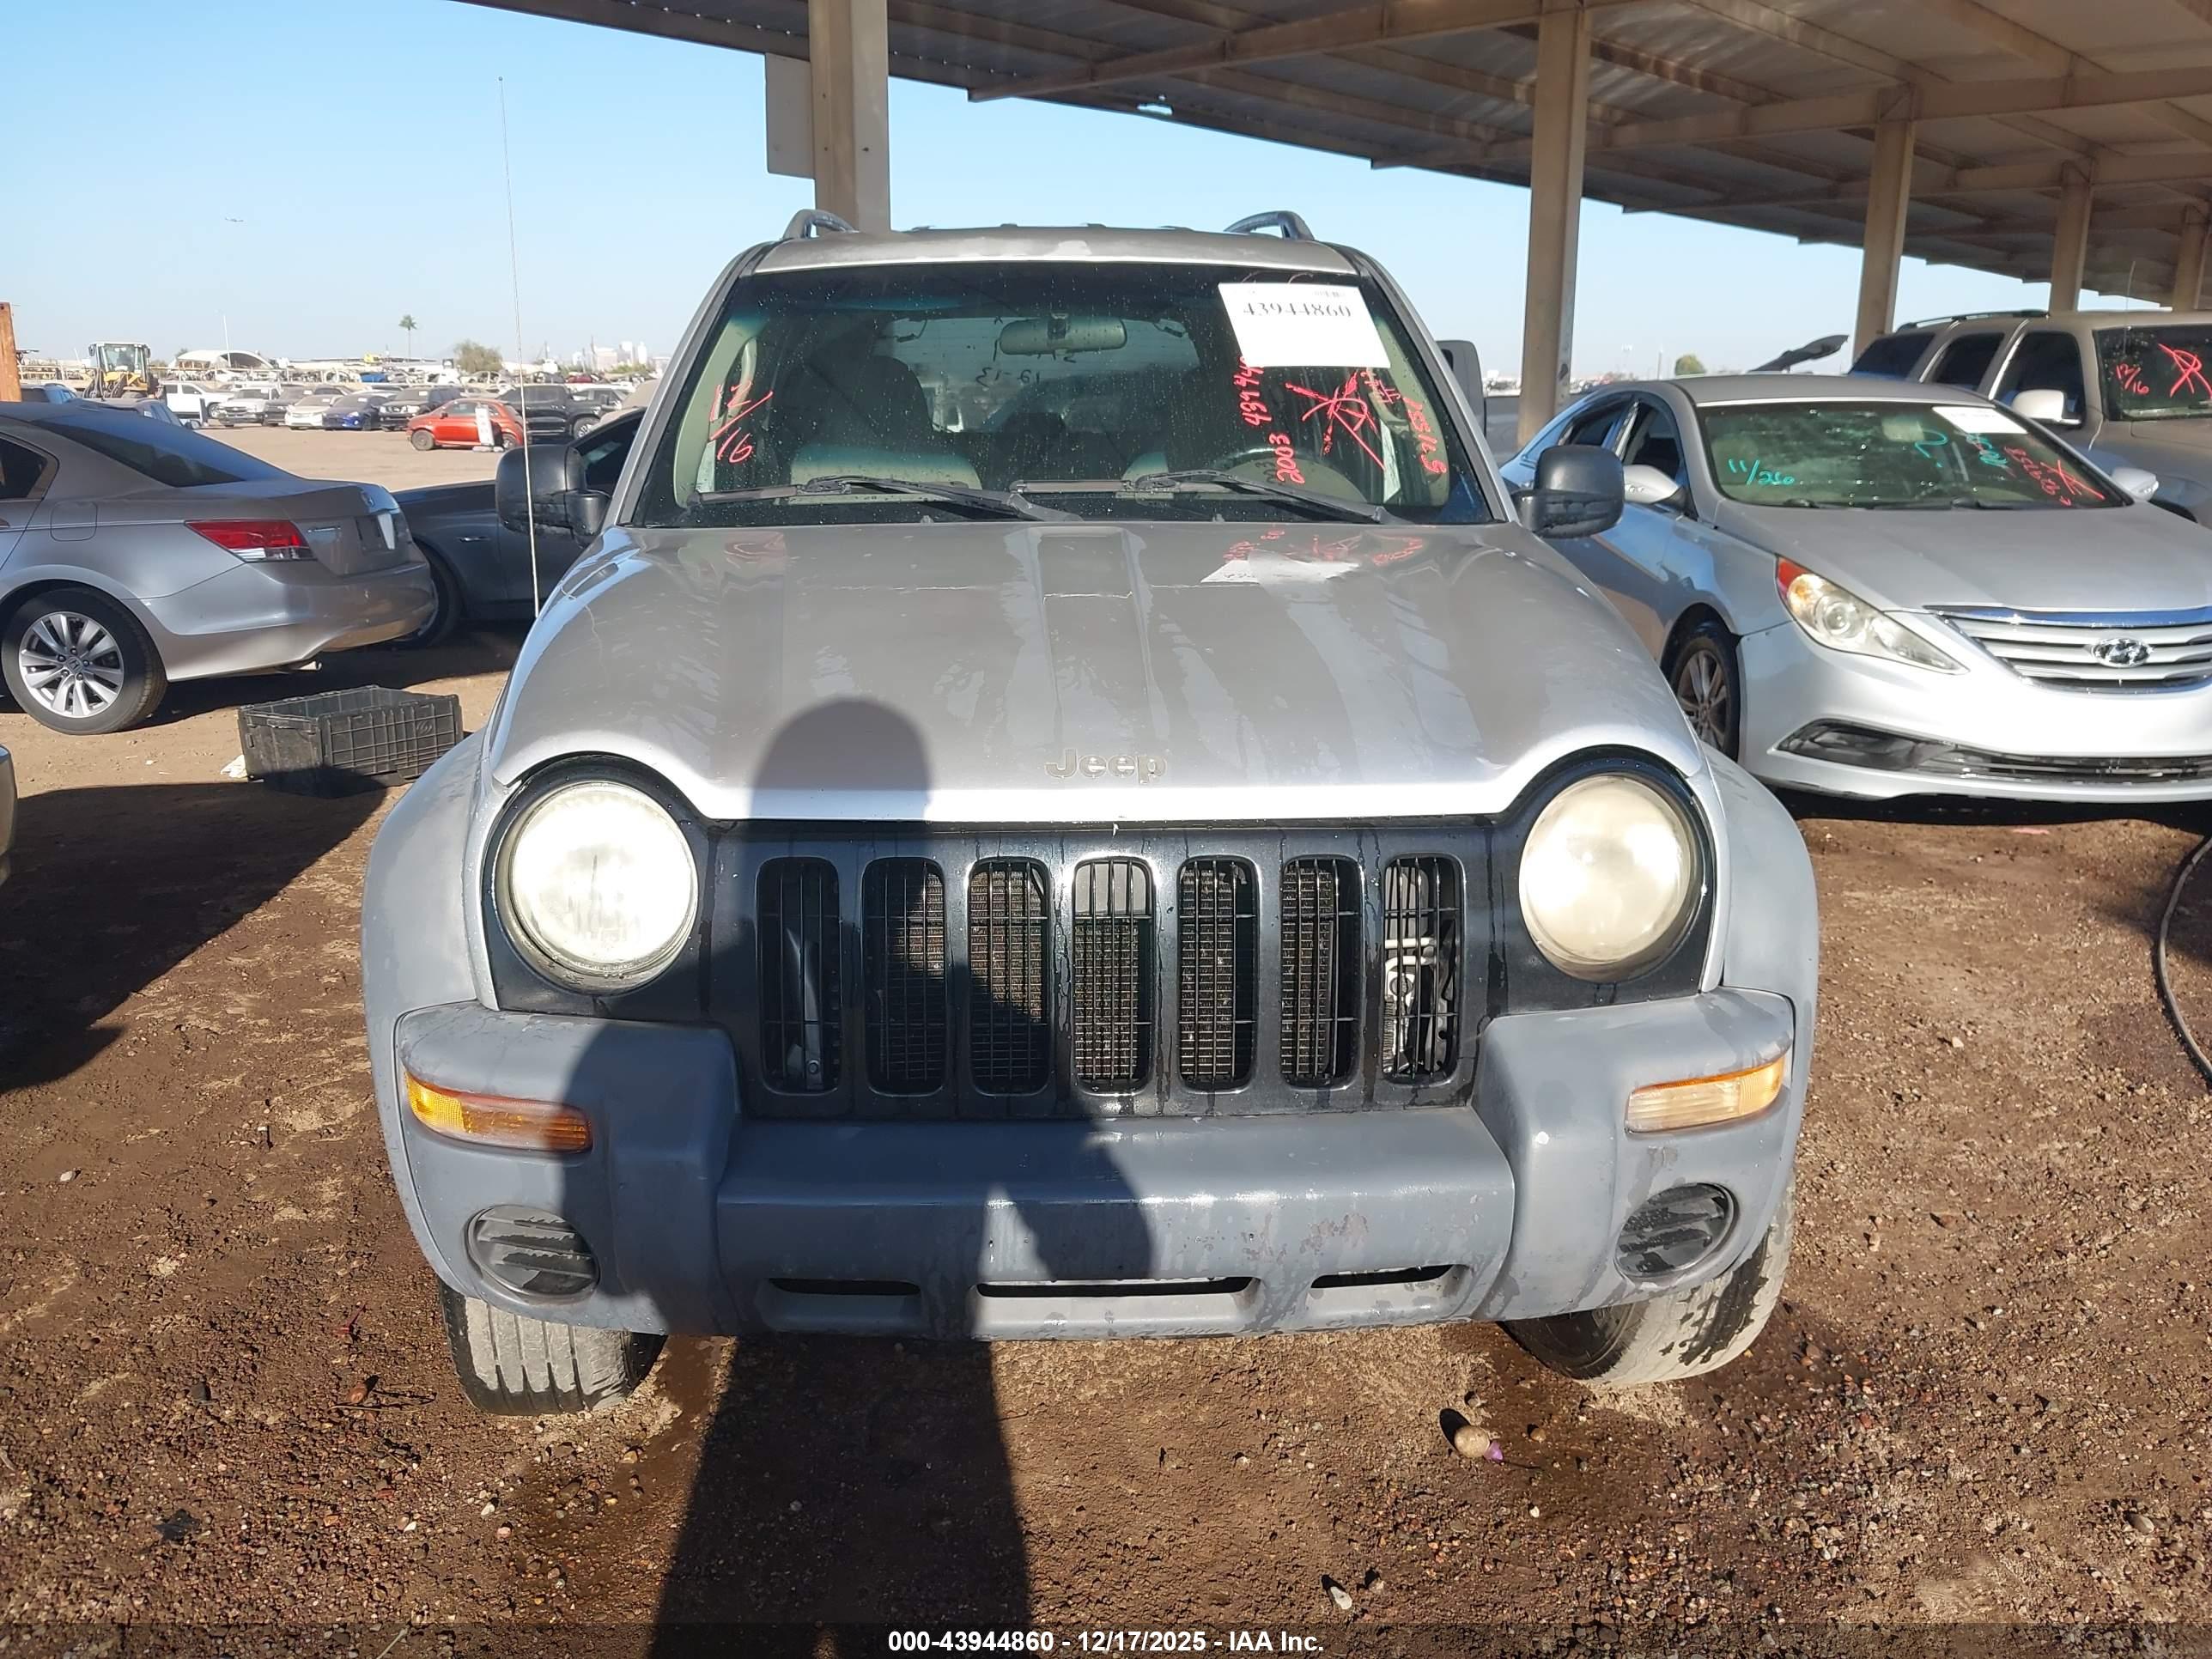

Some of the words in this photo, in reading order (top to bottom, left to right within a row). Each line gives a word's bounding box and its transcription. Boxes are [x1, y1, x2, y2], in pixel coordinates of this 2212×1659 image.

[1243, 301, 1352, 318] 43944860
[1269, 433, 1305, 484] 2003
[1043, 748, 1169, 784] Jeep
